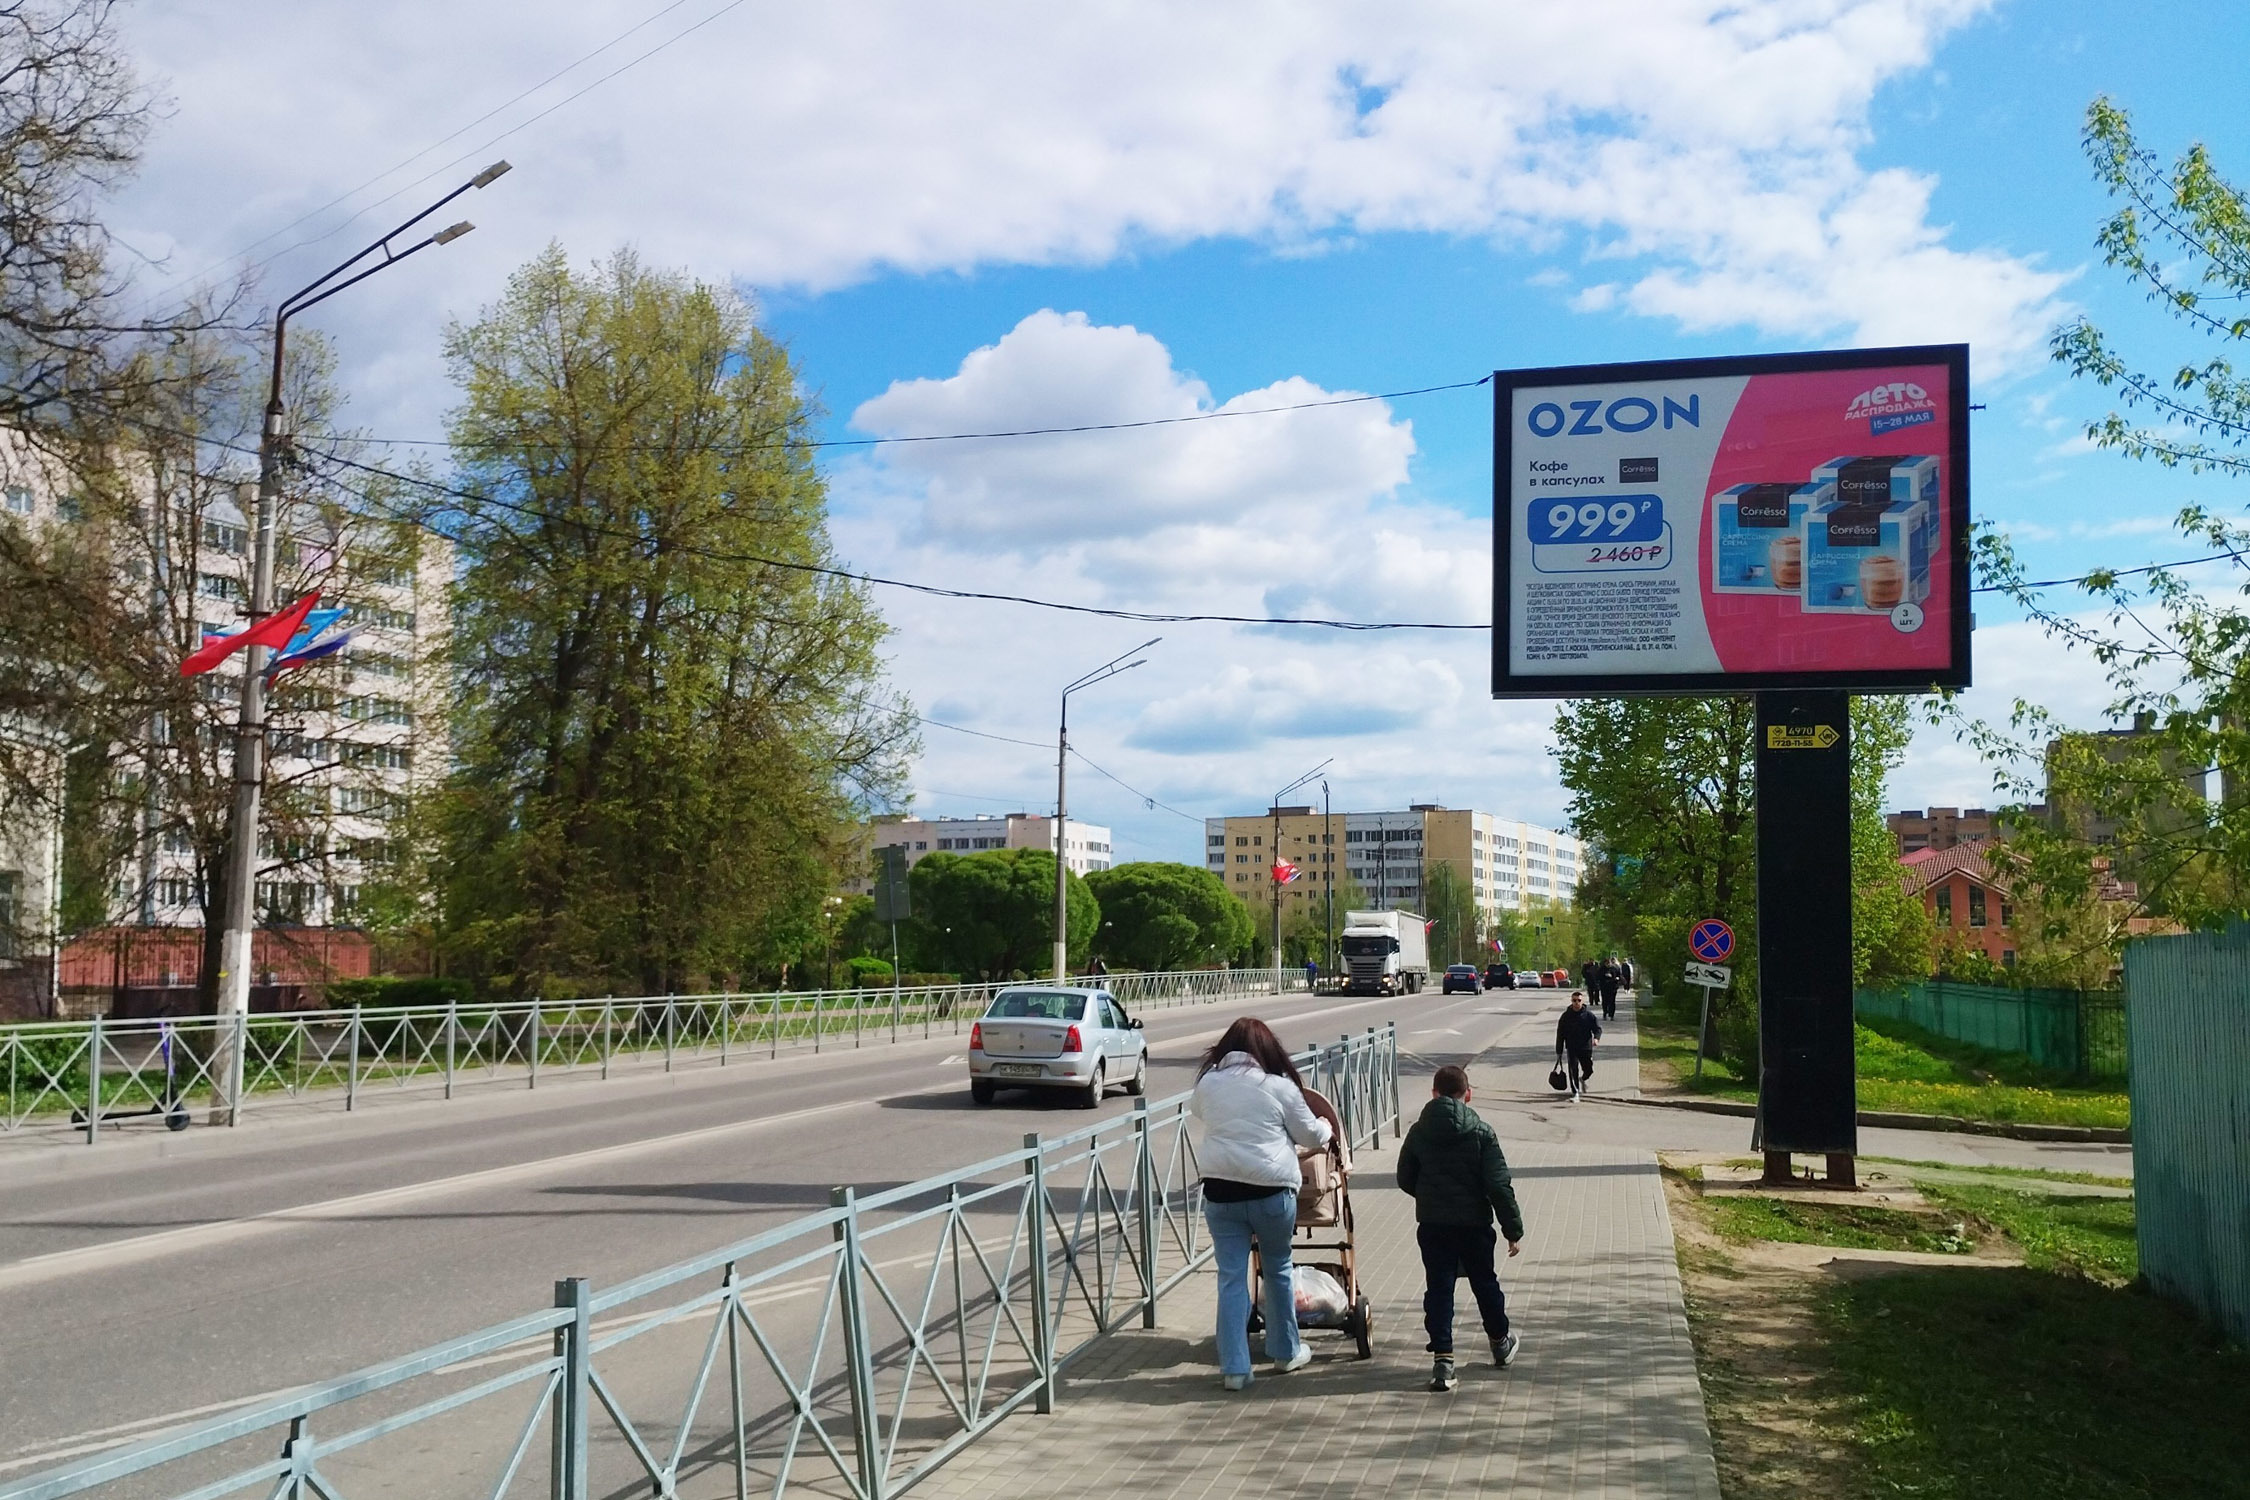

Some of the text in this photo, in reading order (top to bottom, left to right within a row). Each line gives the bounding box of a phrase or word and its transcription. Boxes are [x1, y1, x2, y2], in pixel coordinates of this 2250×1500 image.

[1527, 393, 1700, 438] OZON
[1844, 399, 1937, 421] РАСПРОДАЖА
[1904, 412, 1930, 425] МАЯ
[1529, 460, 1569, 474] Кофе
[1529, 476, 1605, 488] в капсулах
[1548, 502, 1636, 539] 999
[1902, 609, 1909, 617] 3
[1788, 727, 1813, 735] 4970
